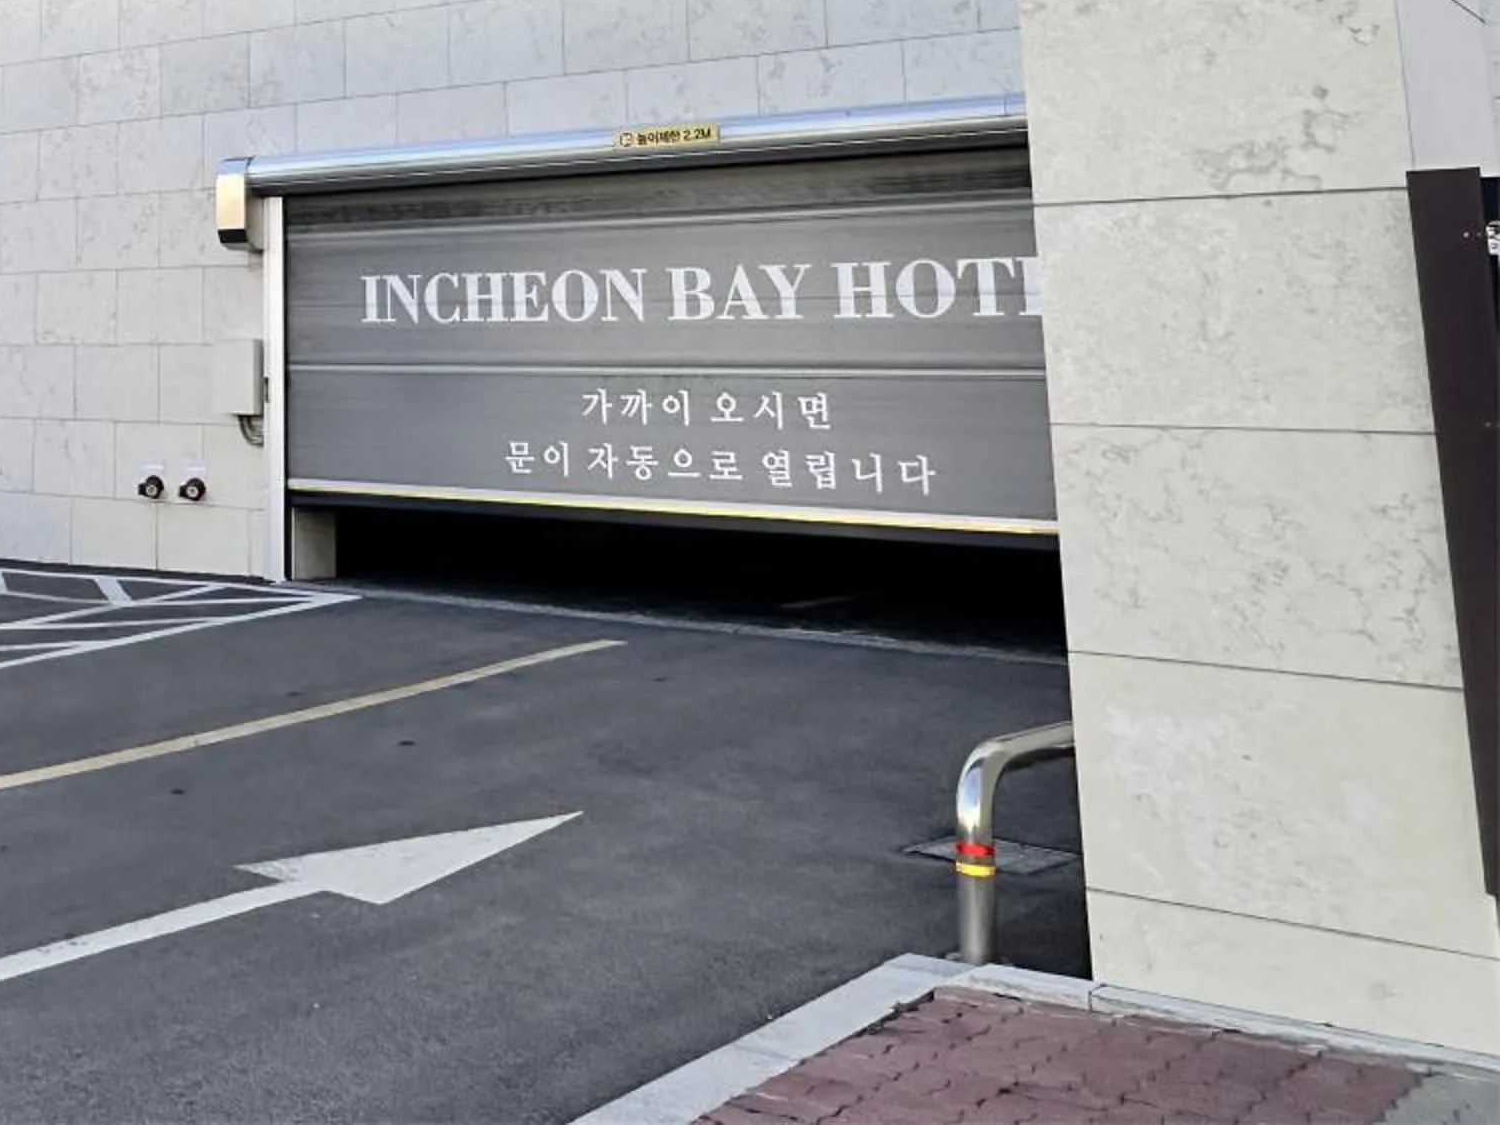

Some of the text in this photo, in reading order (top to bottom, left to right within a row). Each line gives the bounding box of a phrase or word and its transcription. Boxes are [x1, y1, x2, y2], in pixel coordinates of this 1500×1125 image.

[360, 268, 648, 324] INCHEON
[664, 263, 812, 322] BAY
[581, 388, 831, 430] 가까이 오시면
[504, 440, 937, 496] 문이 자동으로 열립니다
